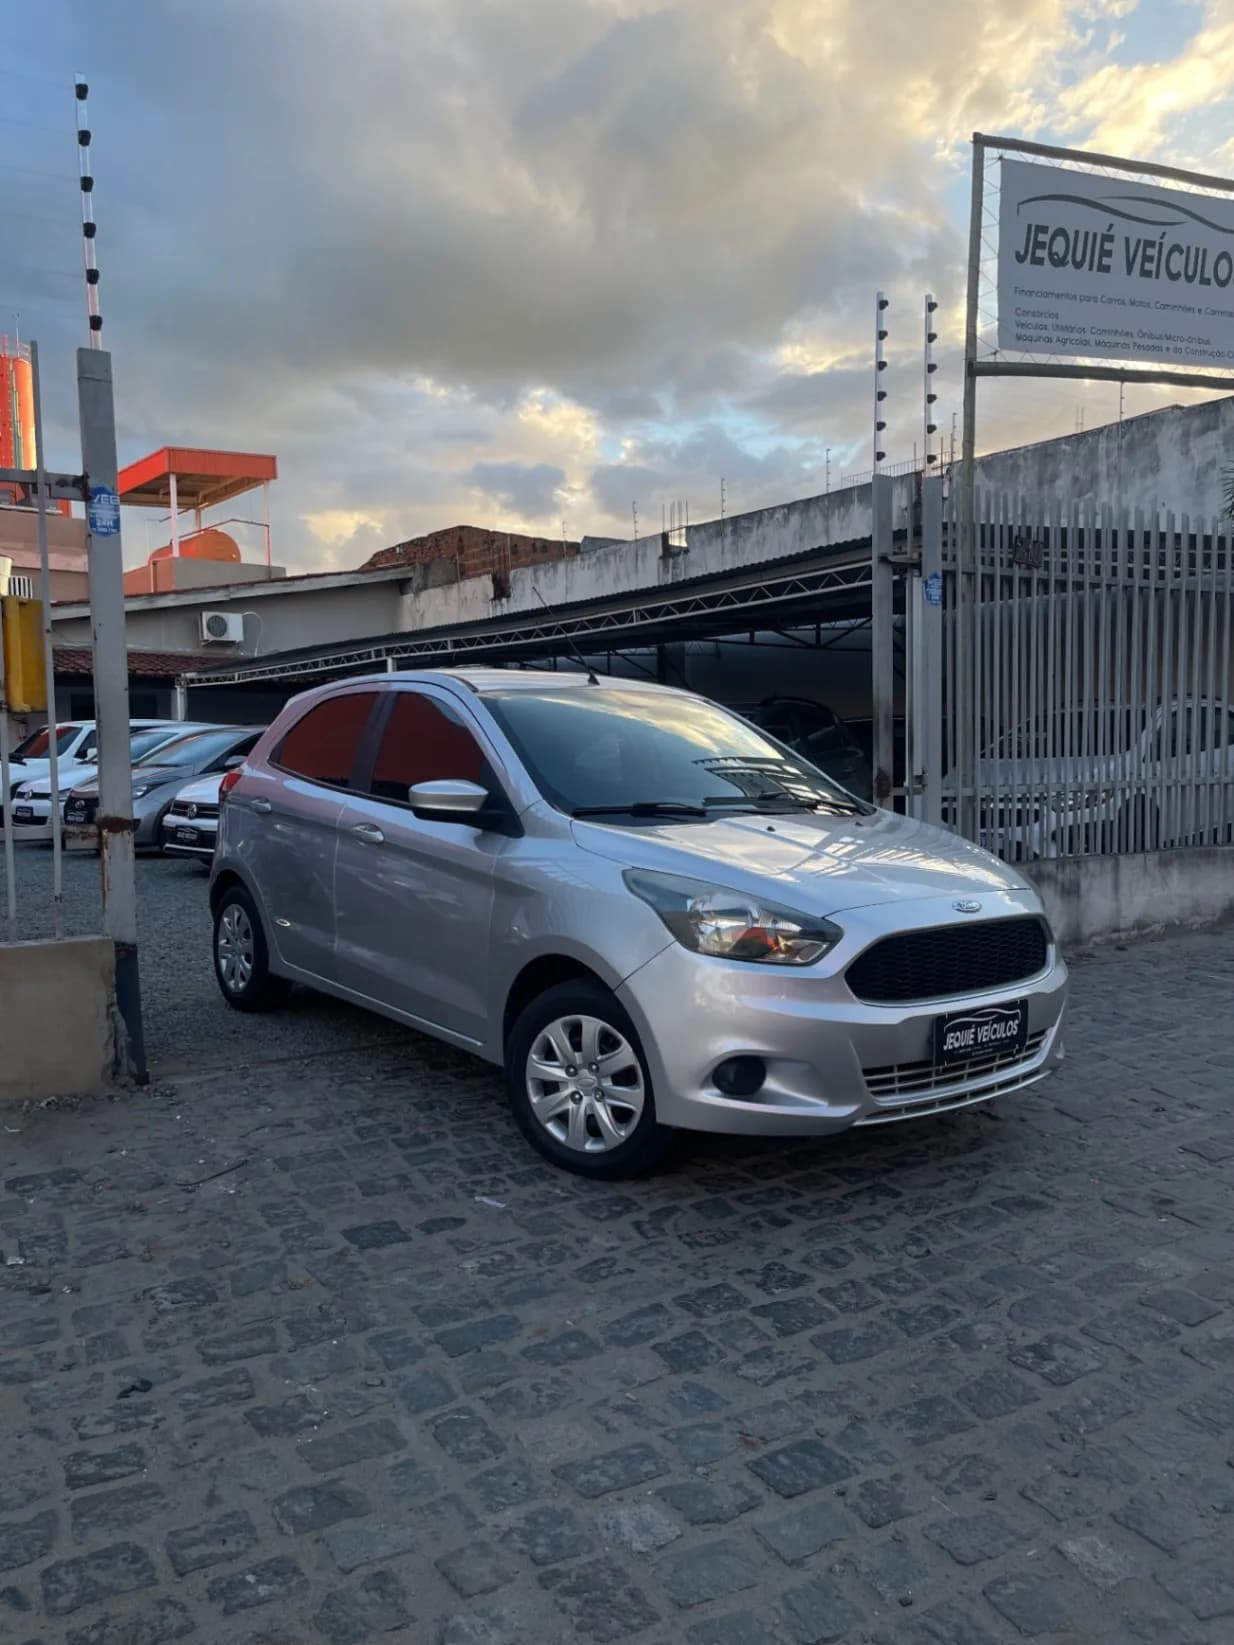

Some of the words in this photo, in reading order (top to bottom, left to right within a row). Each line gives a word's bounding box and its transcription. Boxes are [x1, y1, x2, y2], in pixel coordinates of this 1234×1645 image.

[1015, 223, 1115, 273] JEQUIÉ
[1124, 231, 1234, 288] VEÍCULO
[1014, 286, 1077, 301] Financiamentos
[1079, 294, 1099, 304] para
[1015, 306, 1060, 320] Consórcios
[943, 1023, 976, 1051] JEQUIÉ
[977, 1019, 1019, 1043] VEÍCULOS
